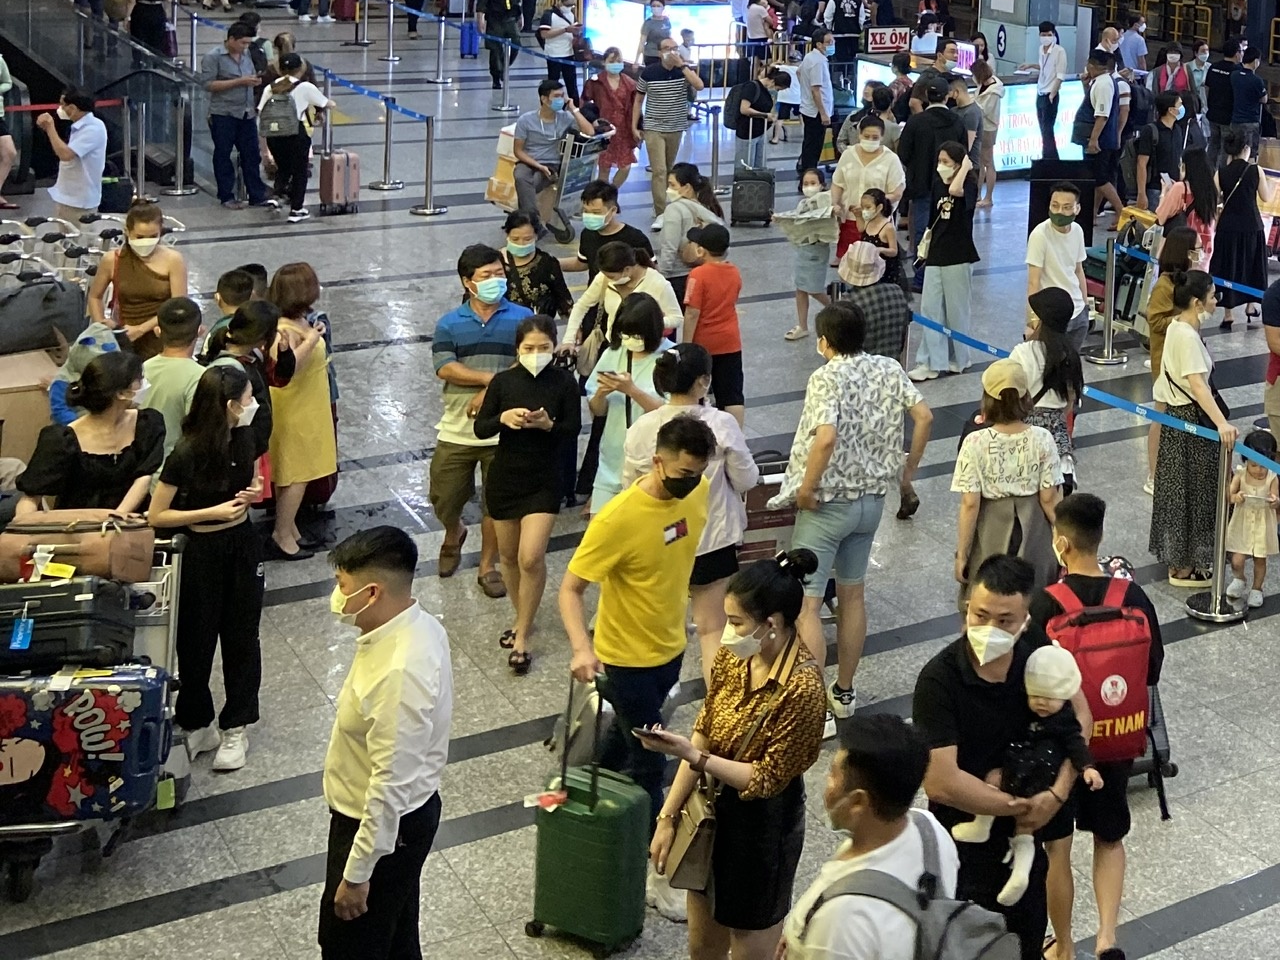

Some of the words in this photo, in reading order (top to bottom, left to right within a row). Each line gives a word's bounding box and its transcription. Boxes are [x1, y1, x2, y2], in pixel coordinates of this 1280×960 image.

[870, 33, 886, 45] XE
[890, 28, 908, 45] ÔM
[998, 32, 1006, 52] 3
[11, 620, 26, 647] Priority
[63, 688, 125, 761] POW!
[1115, 710, 1145, 736] NAM
